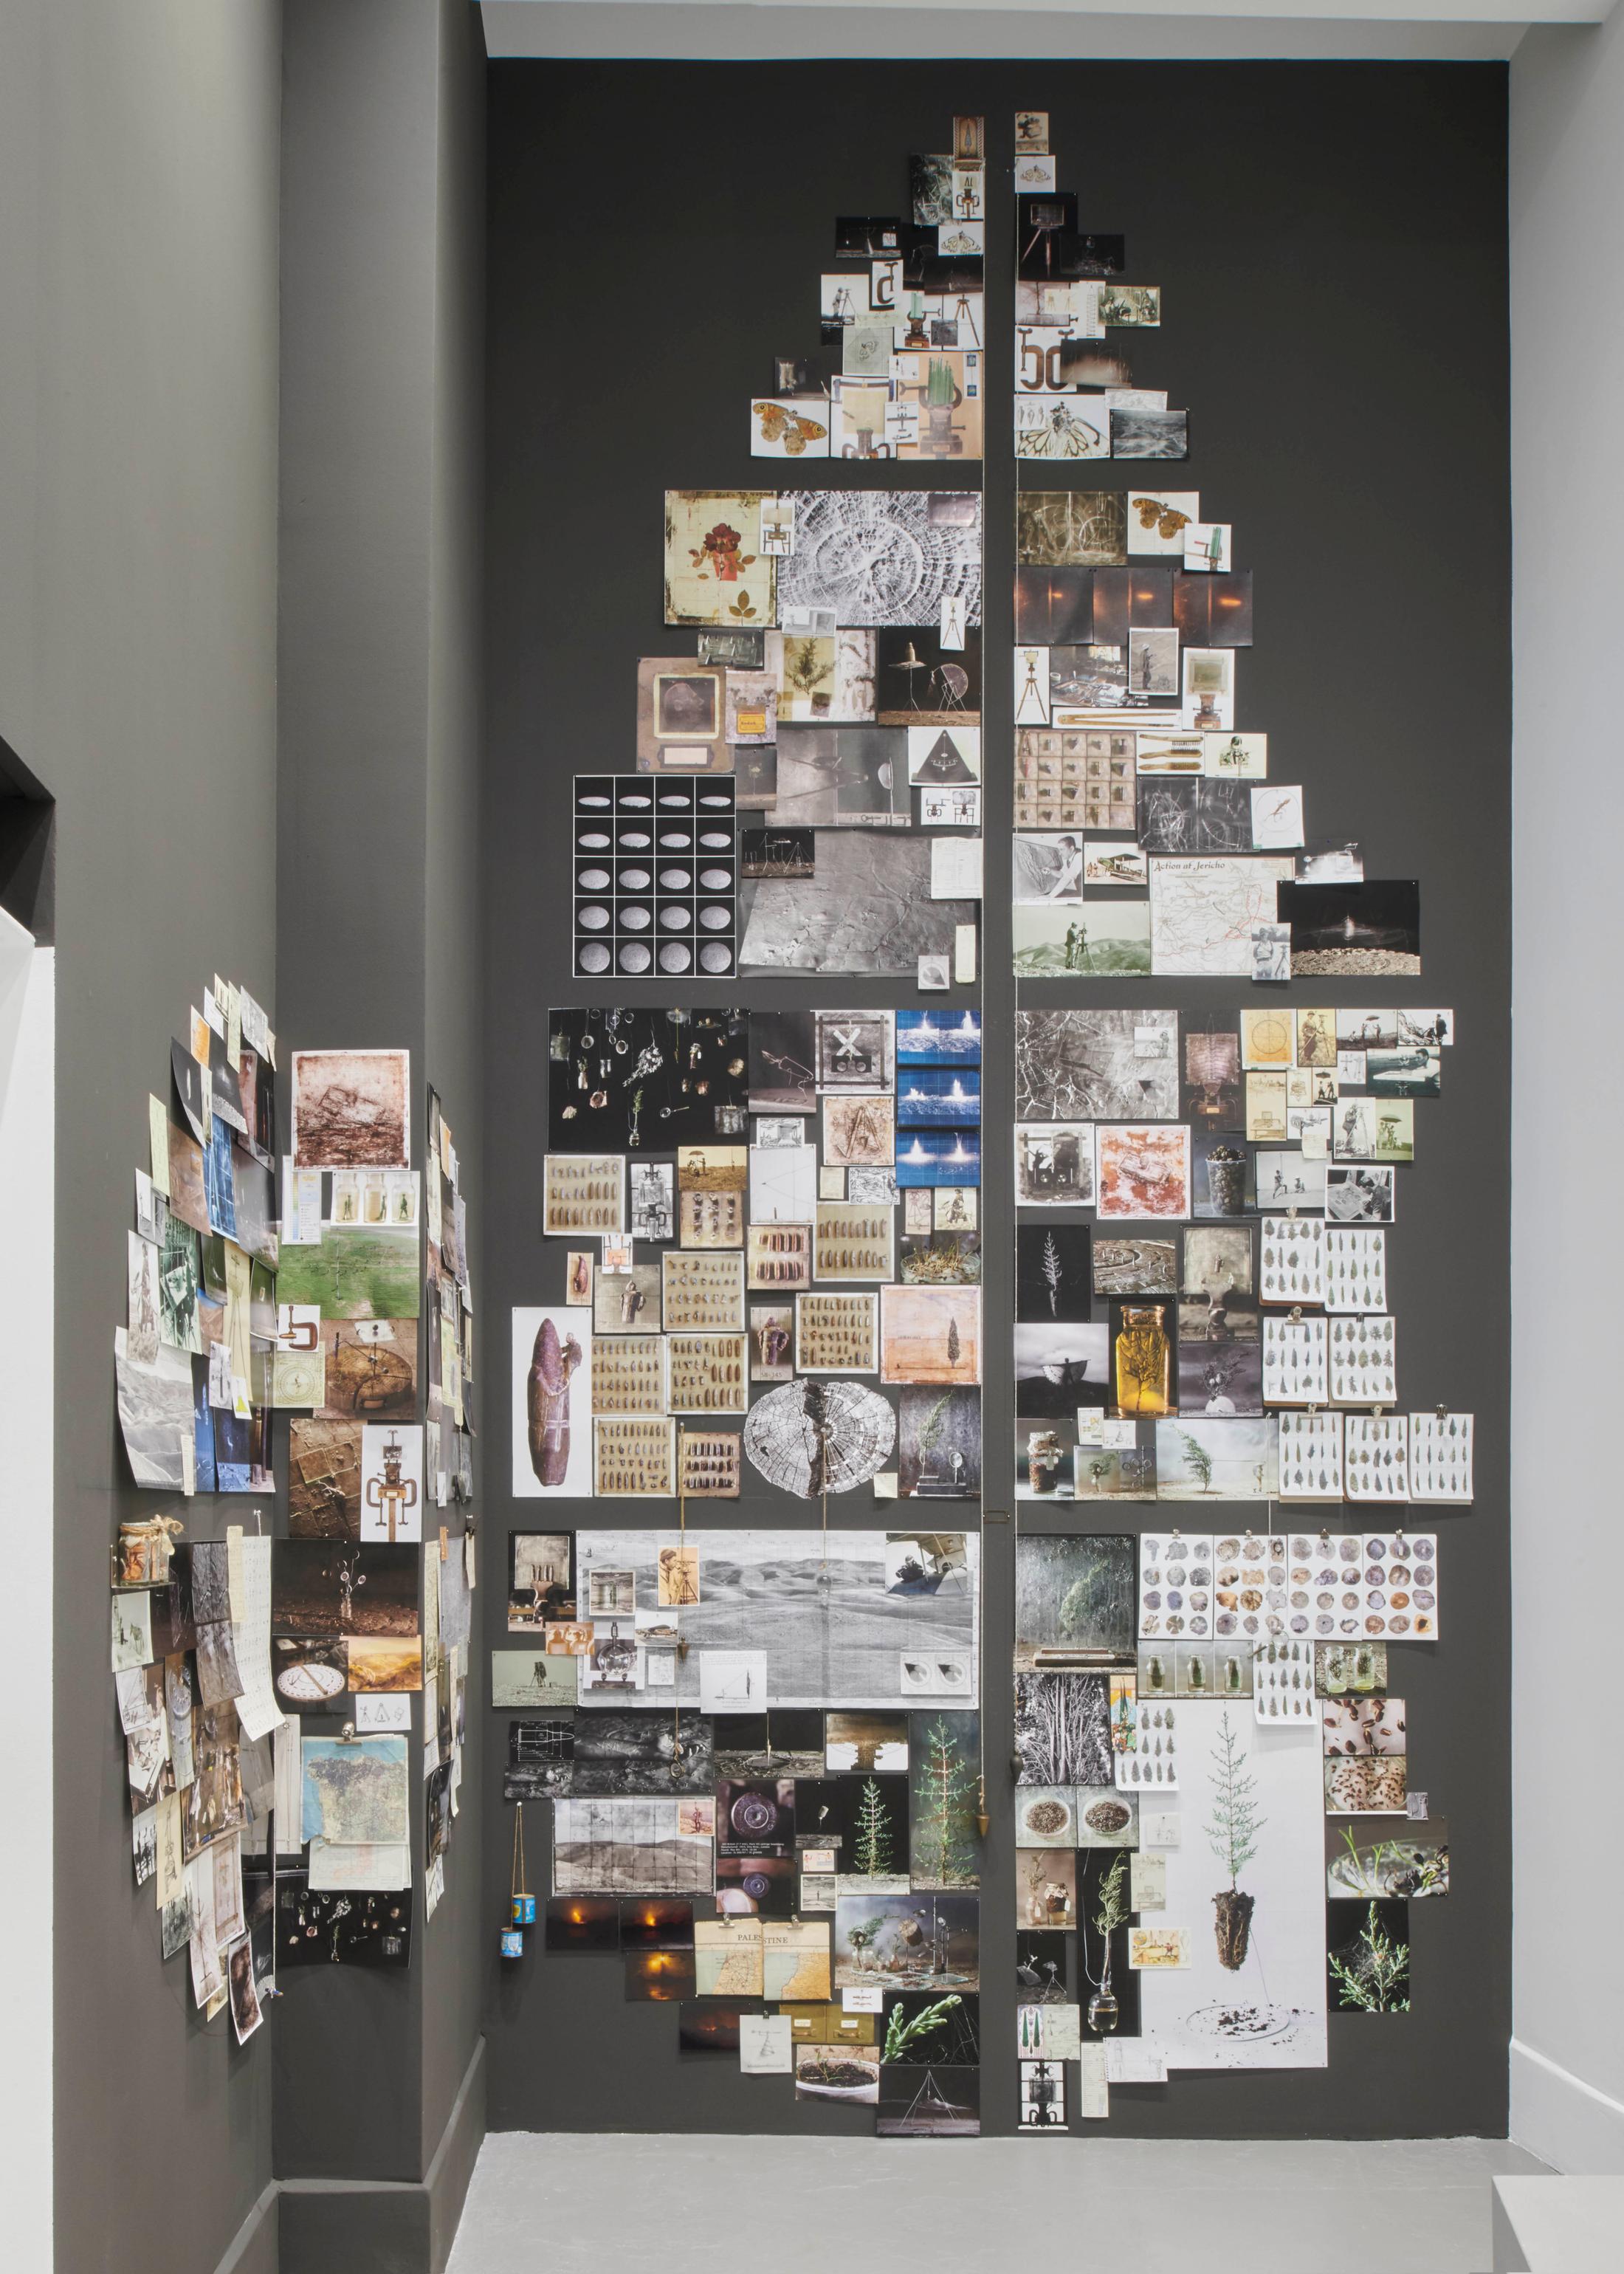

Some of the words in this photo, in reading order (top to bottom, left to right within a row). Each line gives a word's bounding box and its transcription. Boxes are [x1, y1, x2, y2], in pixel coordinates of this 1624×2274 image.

[1154, 861, 1180, 871] Action
[1183, 862, 1191, 870] at
[1193, 861, 1225, 871] Jericho
